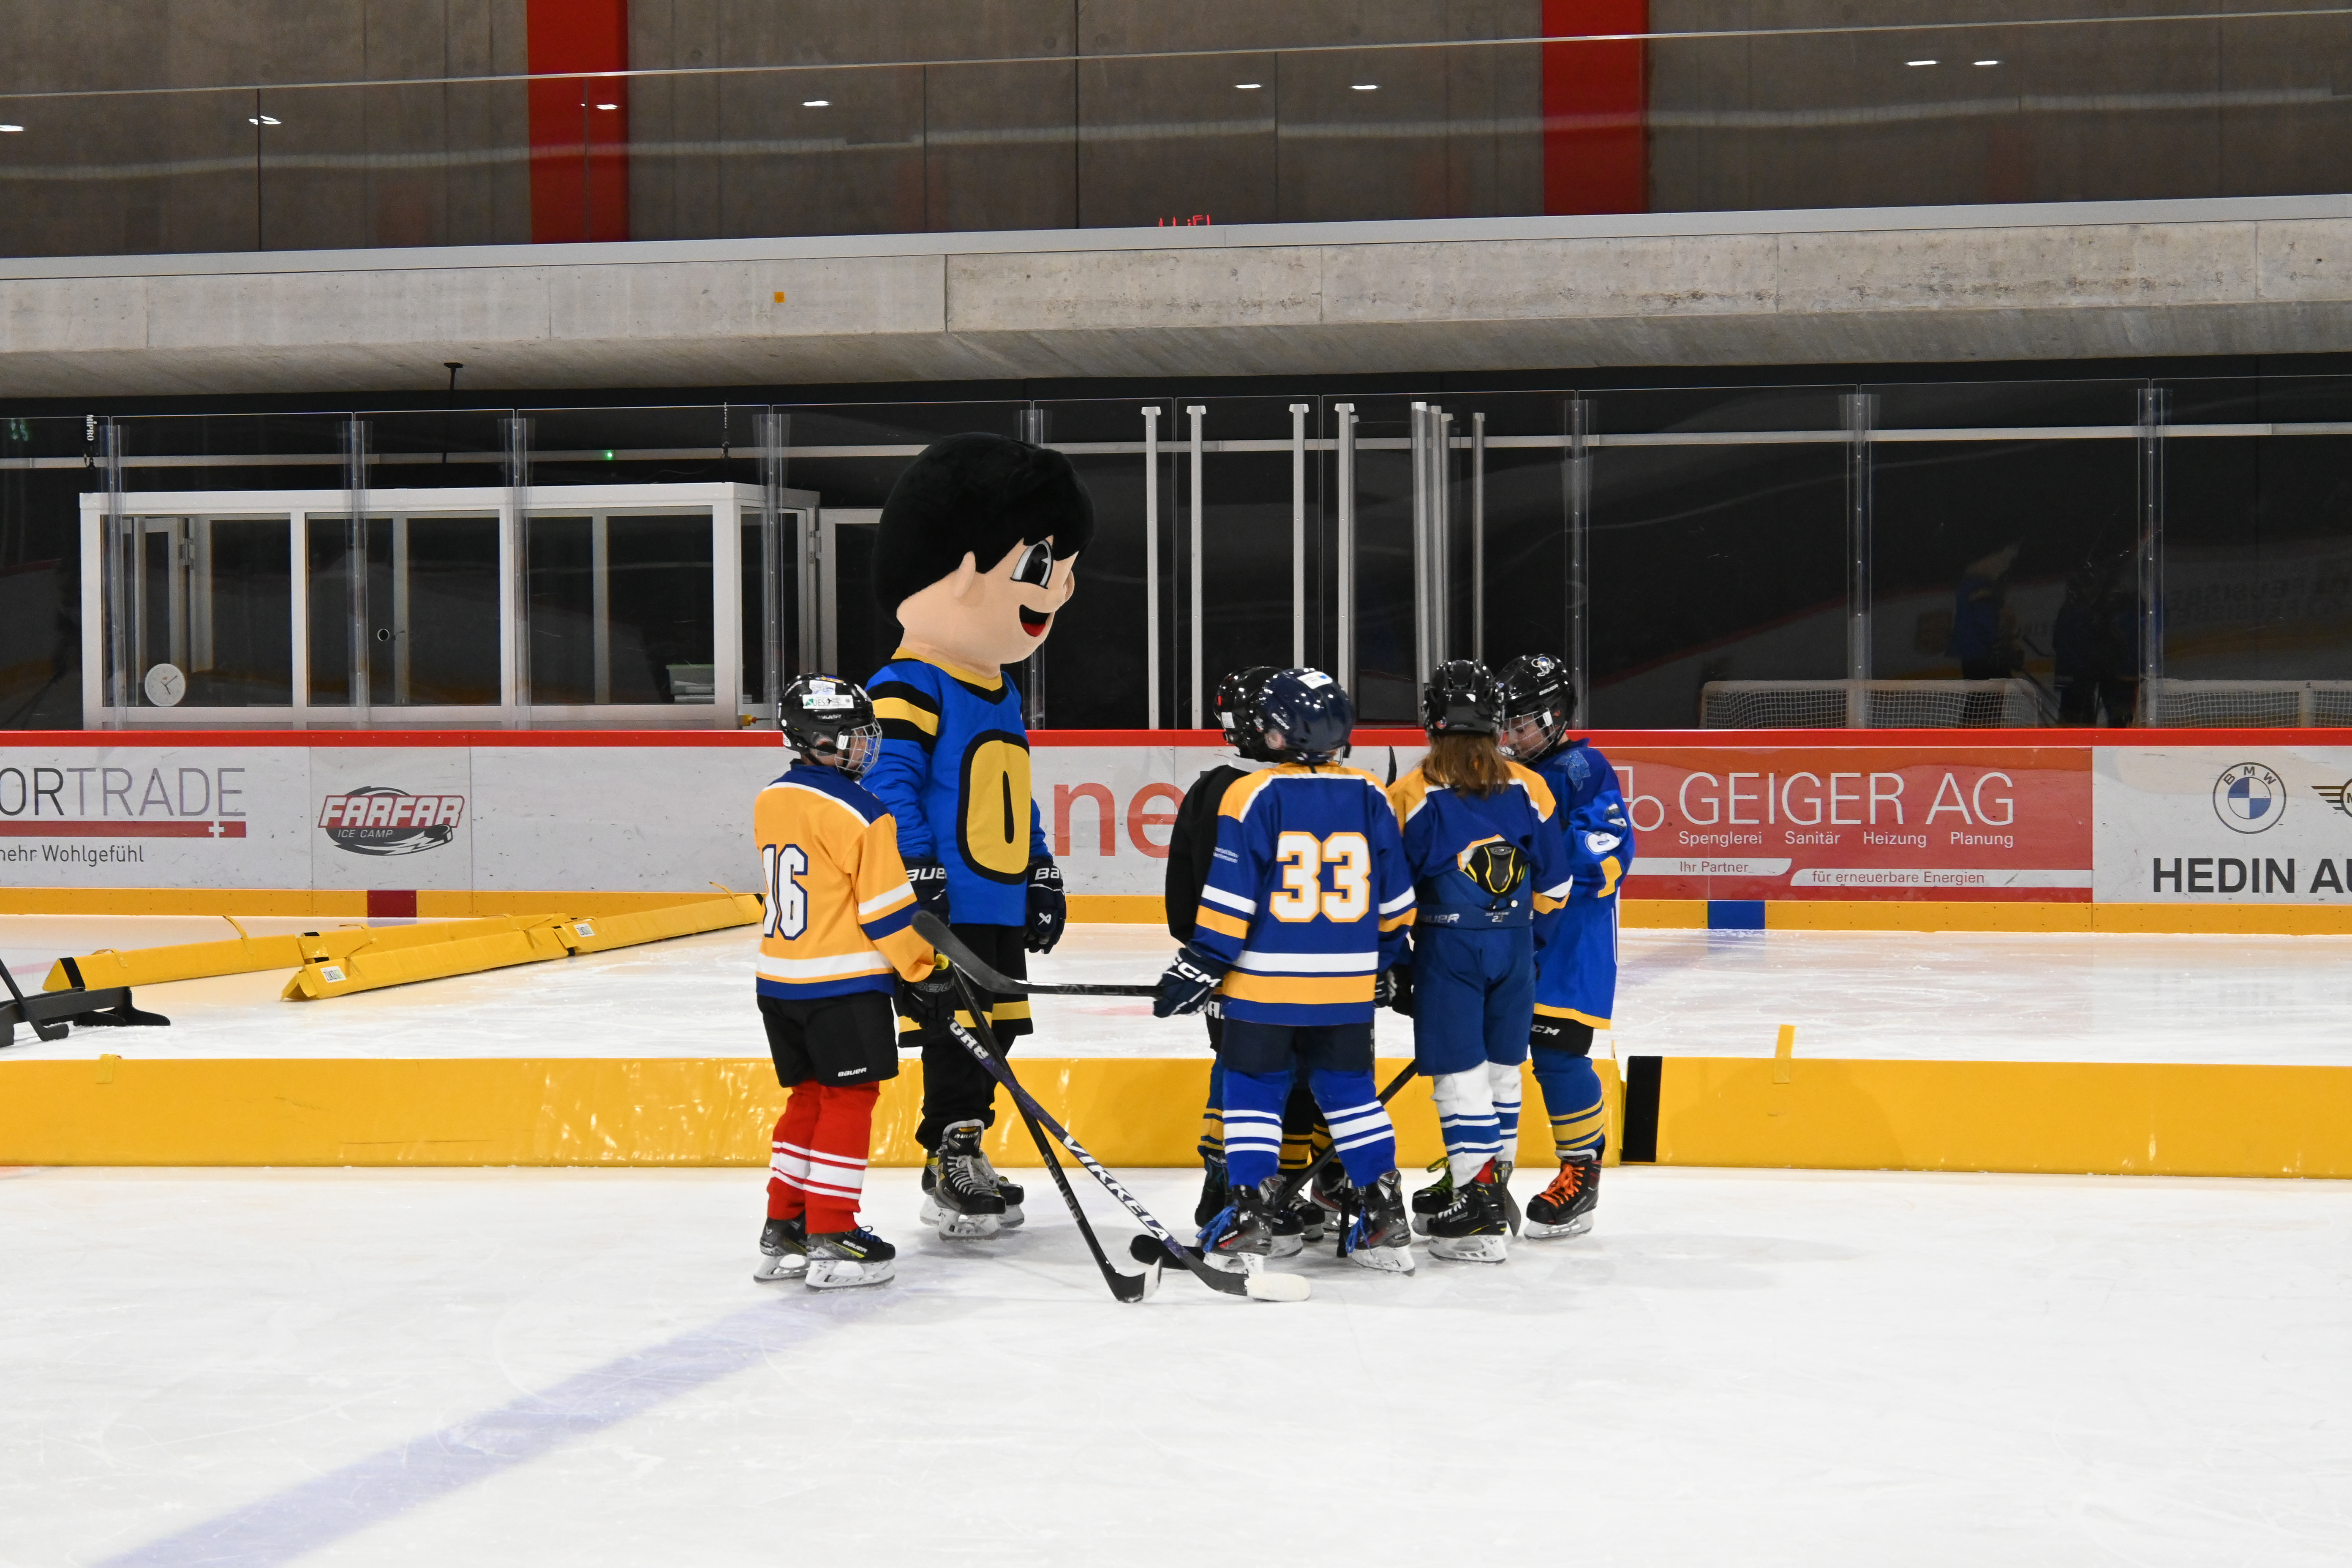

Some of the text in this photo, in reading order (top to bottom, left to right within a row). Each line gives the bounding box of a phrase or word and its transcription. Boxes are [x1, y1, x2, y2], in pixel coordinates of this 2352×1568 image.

[2223, 766, 2276, 785] BMW
[0, 767, 246, 817] ORTRADE
[1678, 772, 2014, 826] GEIGER AG
[319, 797, 463, 826] FARFAR
[338, 829, 393, 838] ICE CAMP
[1679, 830, 2014, 848] Spenglerei Sanitär Heizung Planung
[42, 845, 144, 867] Wohlgefühl
[1680, 861, 1749, 873] Ihr Partner
[1269, 831, 1371, 923] 33
[1812, 870, 1984, 887] für erneuerbare Energien
[2153, 858, 2352, 894] HEDIN A
[1531, 1024, 1560, 1036] CM
[1063, 1135, 1169, 1241] VIKKELA
